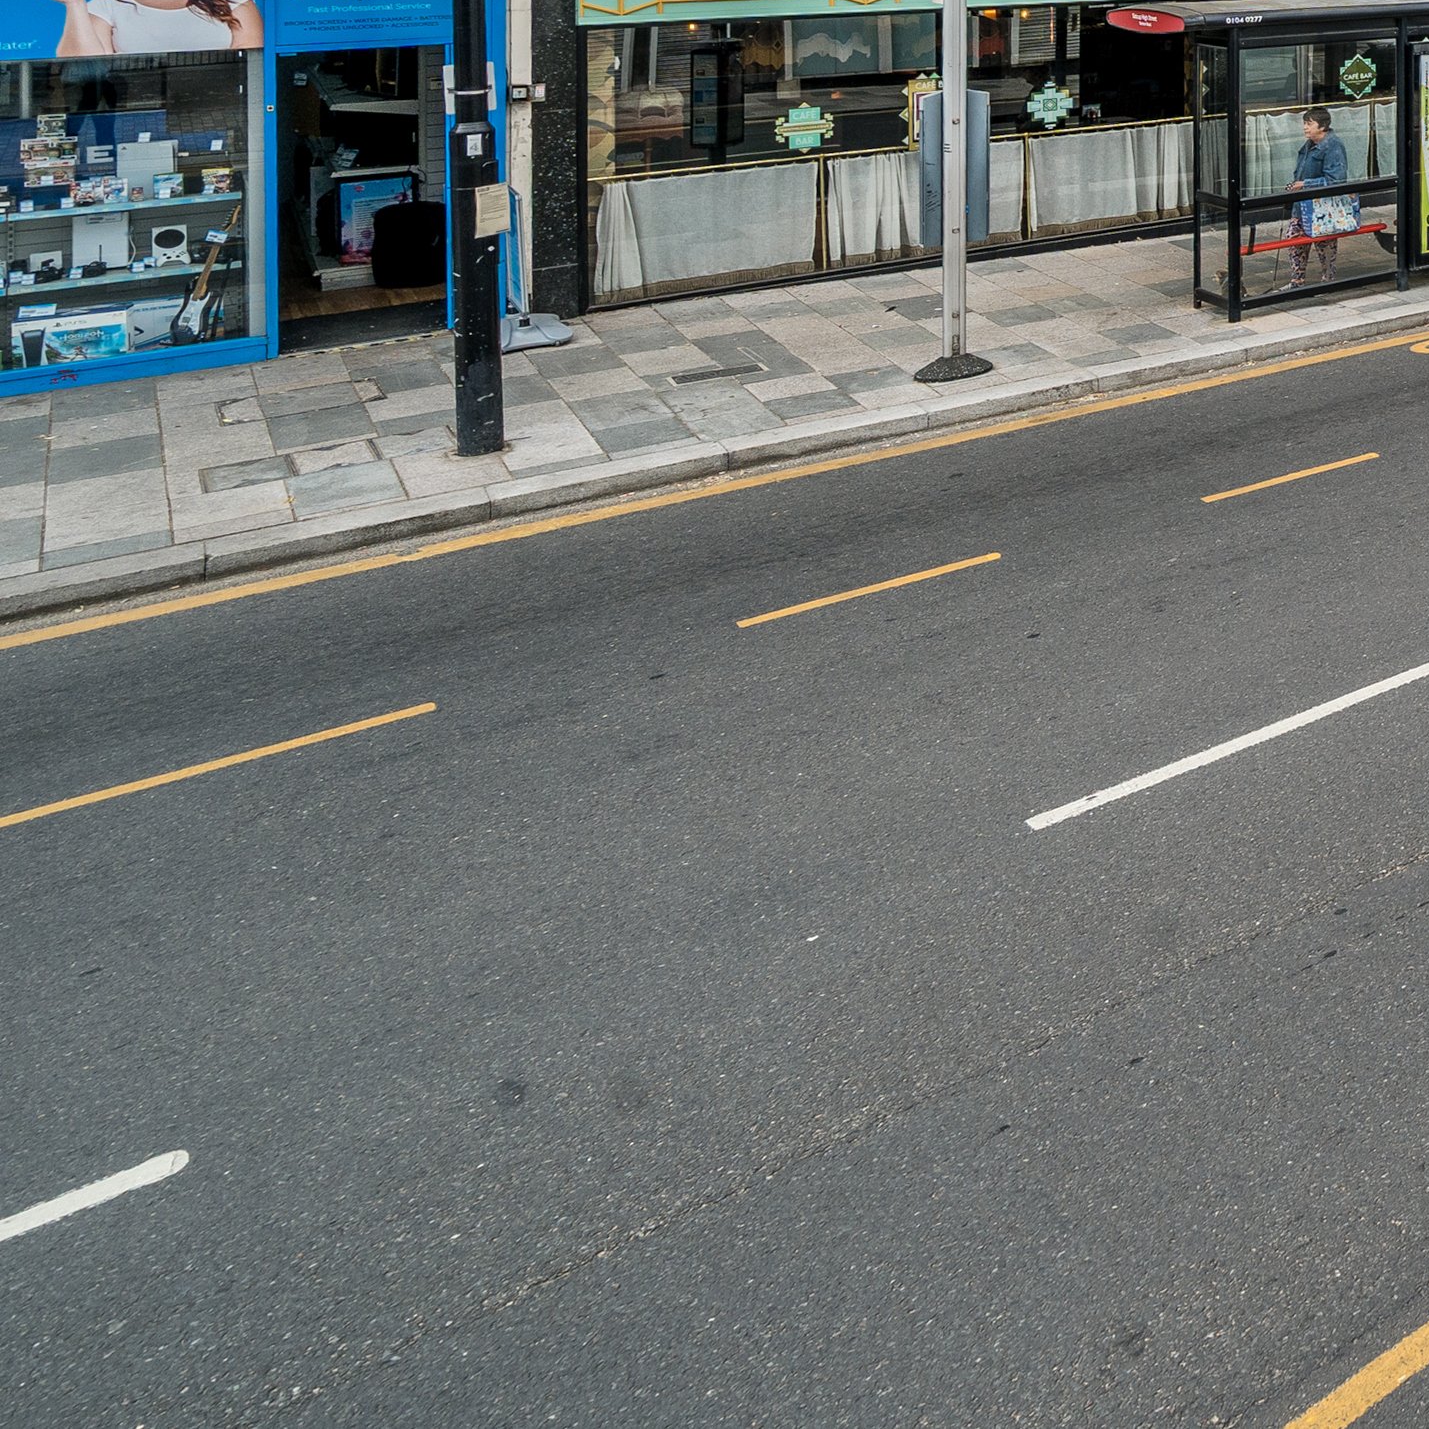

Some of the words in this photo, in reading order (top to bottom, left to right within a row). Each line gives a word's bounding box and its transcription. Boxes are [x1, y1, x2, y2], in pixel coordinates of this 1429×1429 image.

[331, 4, 393, 12] Professional
[396, 2, 432, 10] Service
[1360, 72, 1372, 80] BAR
[795, 136, 814, 146] BAR
